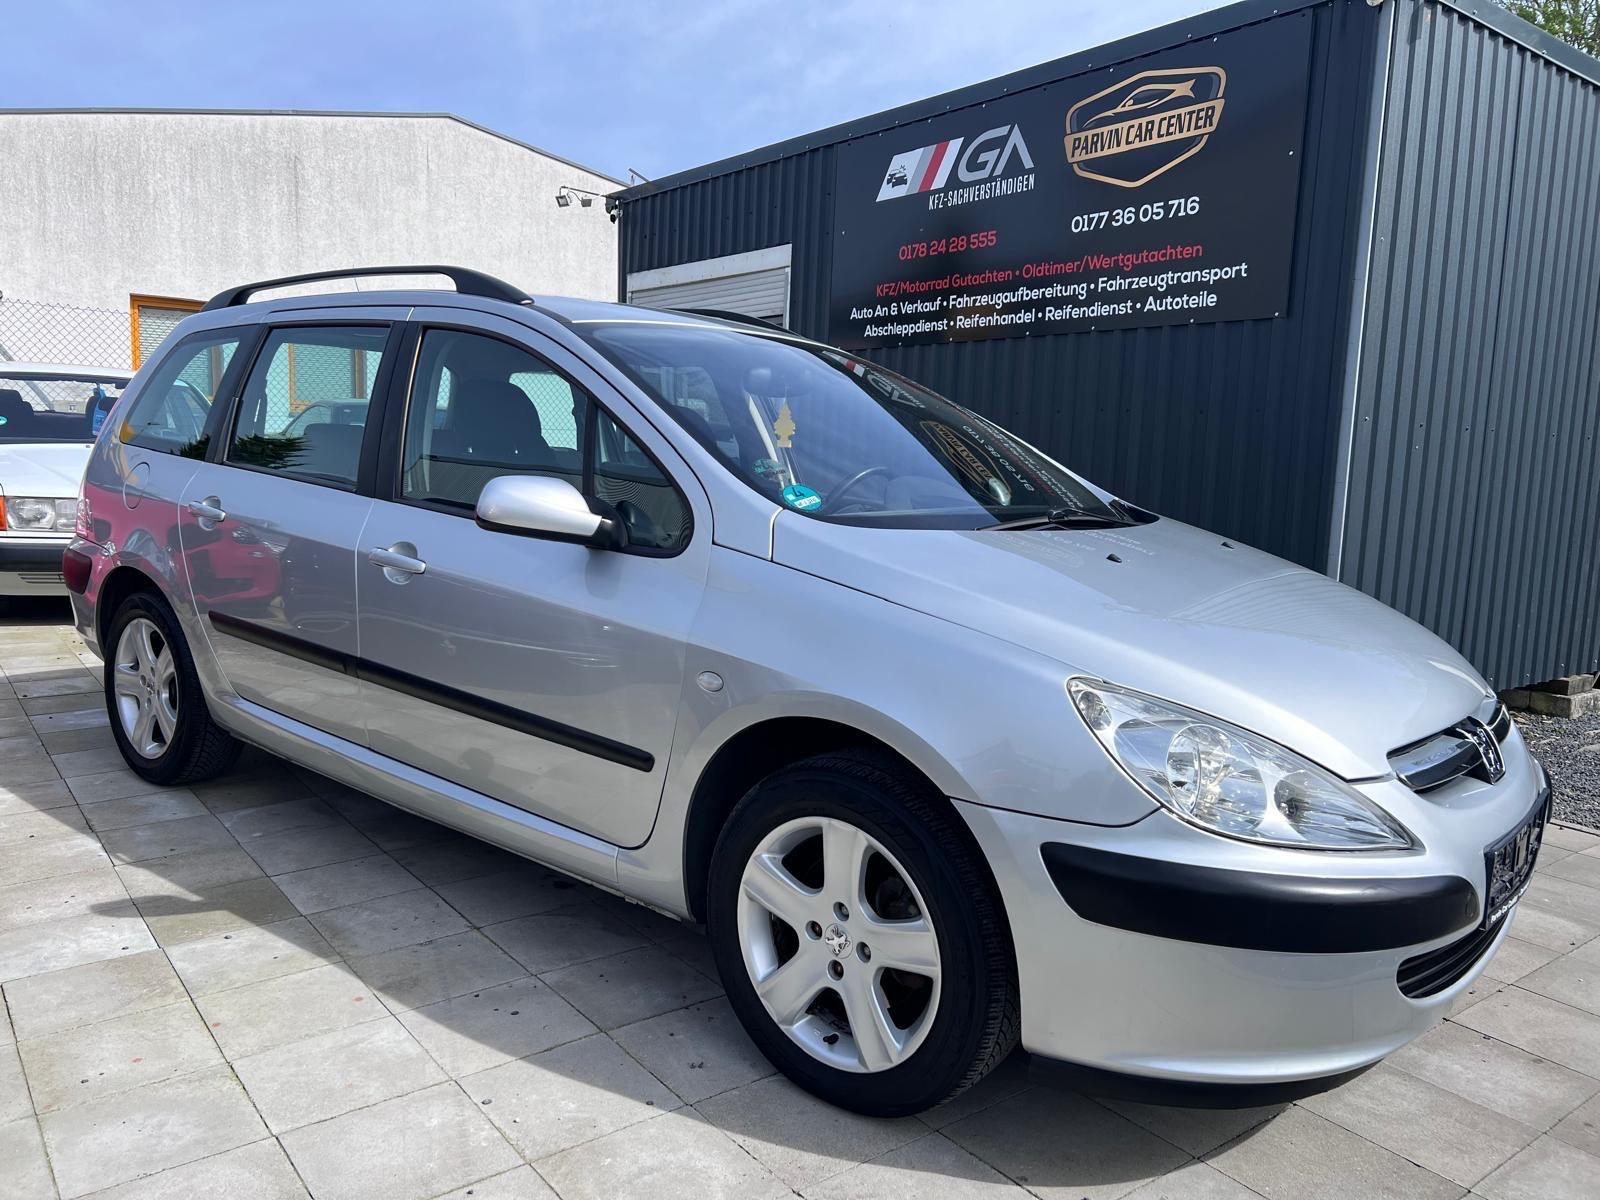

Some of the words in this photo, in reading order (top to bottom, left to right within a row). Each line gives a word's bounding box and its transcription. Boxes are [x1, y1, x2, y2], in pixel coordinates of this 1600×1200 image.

[1071, 127, 1124, 157] PARVIN
[1125, 120, 1154, 145] CAR
[1157, 105, 1216, 138] CENTER
[929, 174, 1034, 210] KFZ-SACHVERSTÄNDIGEN
[1072, 211, 1109, 232] 0177
[1112, 207, 1135, 226] 36
[1140, 202, 1164, 222] 05
[1168, 196, 1200, 218] 716
[899, 244, 926, 260] 0178
[930, 240, 946, 255] 24
[950, 236, 967, 252] 28
[970, 231, 997, 248] 555
[850, 307, 872, 320] Auto
[875, 305, 888, 317] An
[890, 303, 898, 315] &
[900, 297, 941, 314] Verkauf
[950, 282, 1086, 309] Fahrzeugaufbereitung
[1098, 263, 1248, 292] Fahrzeugtransport
[876, 276, 949, 296] KFZ/Motorrad
[952, 270, 1012, 288] Gutachten
[1022, 245, 1203, 278] Oldtimer/Wertgutachten
[864, 318, 948, 337] Abschleppdienst
[957, 309, 1035, 329] Reifenhandel
[1045, 300, 1132, 320] Reifendienst
[1144, 291, 1217, 312] Autoteile
